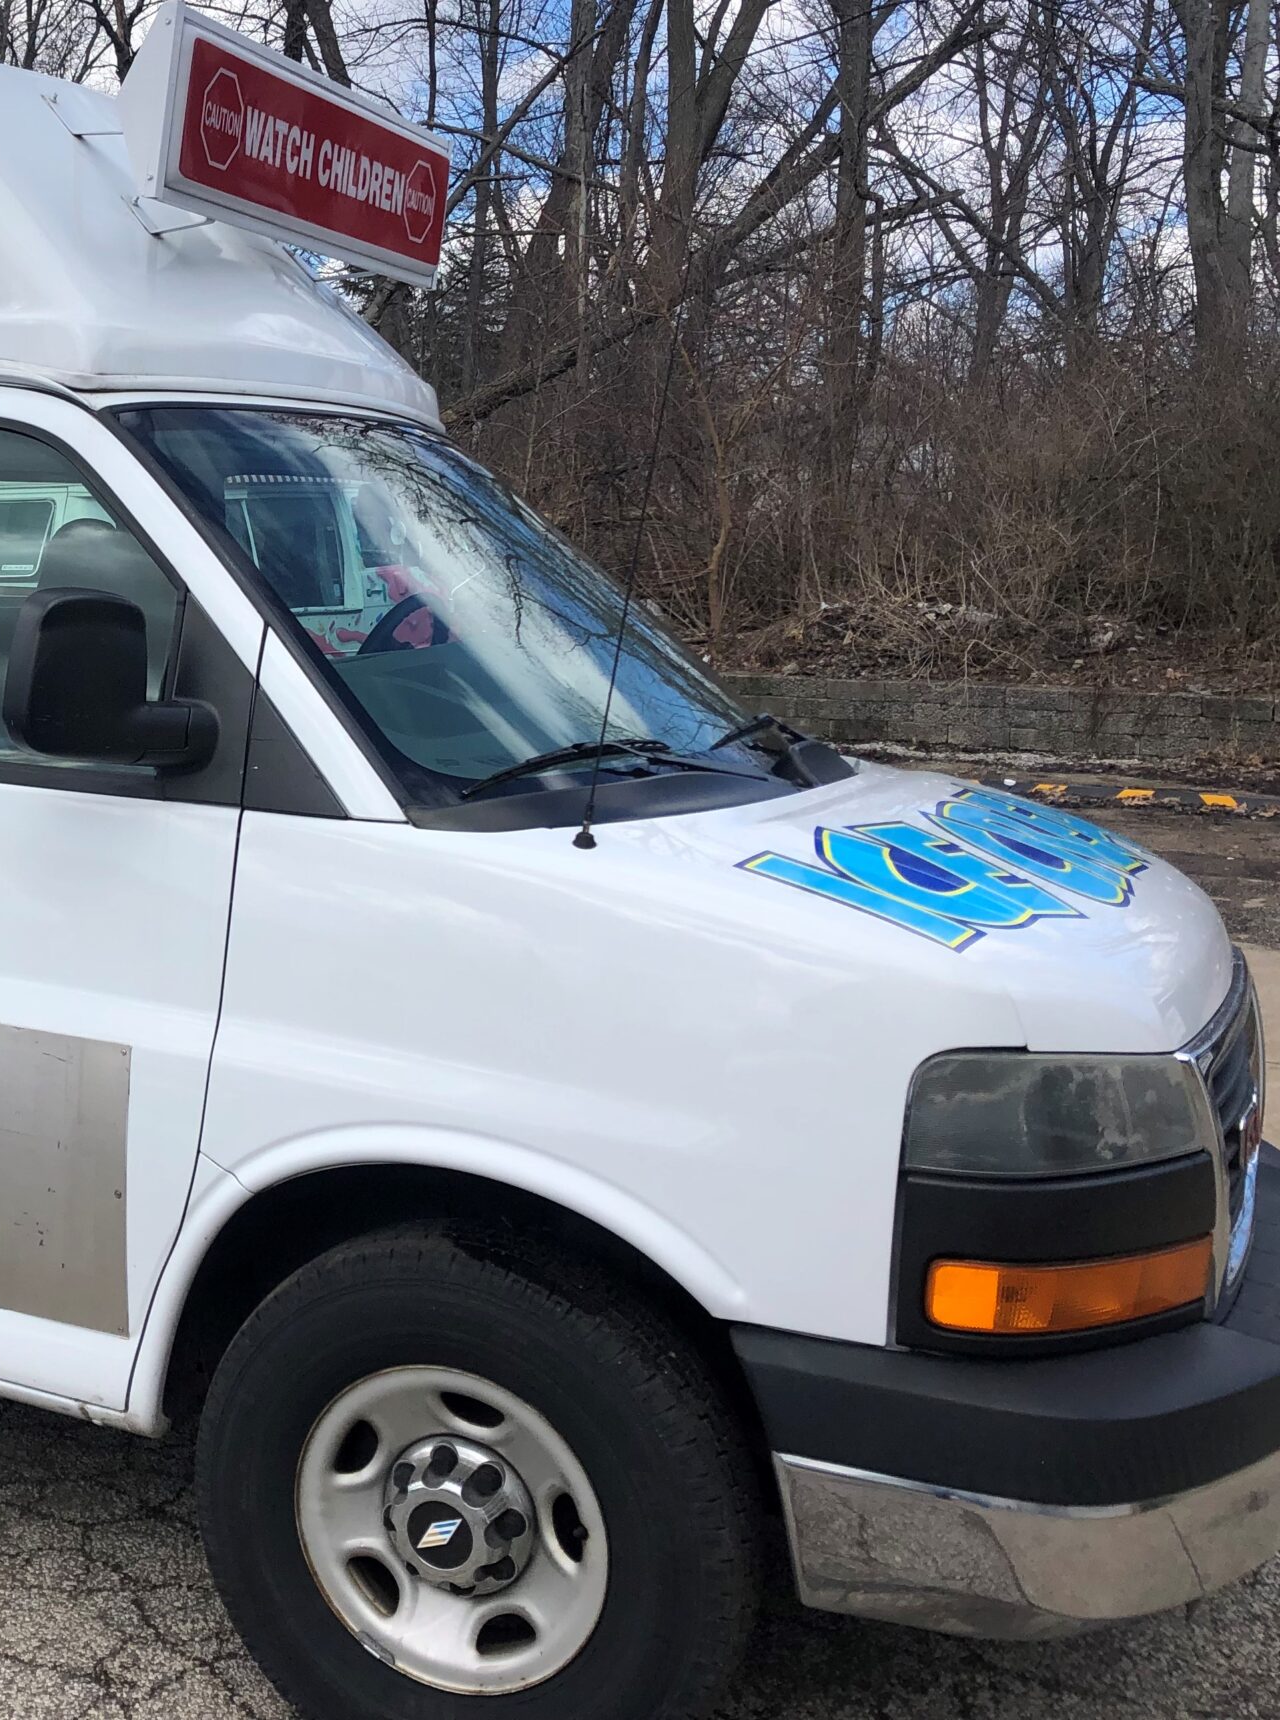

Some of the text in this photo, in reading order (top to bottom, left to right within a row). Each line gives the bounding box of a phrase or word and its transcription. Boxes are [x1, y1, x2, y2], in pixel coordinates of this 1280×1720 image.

[205, 101, 240, 138] CAUTION
[245, 105, 406, 216] WATCH CHILDREN
[407, 187, 435, 217] CAUTION
[733, 820, 1089, 953] ICE
